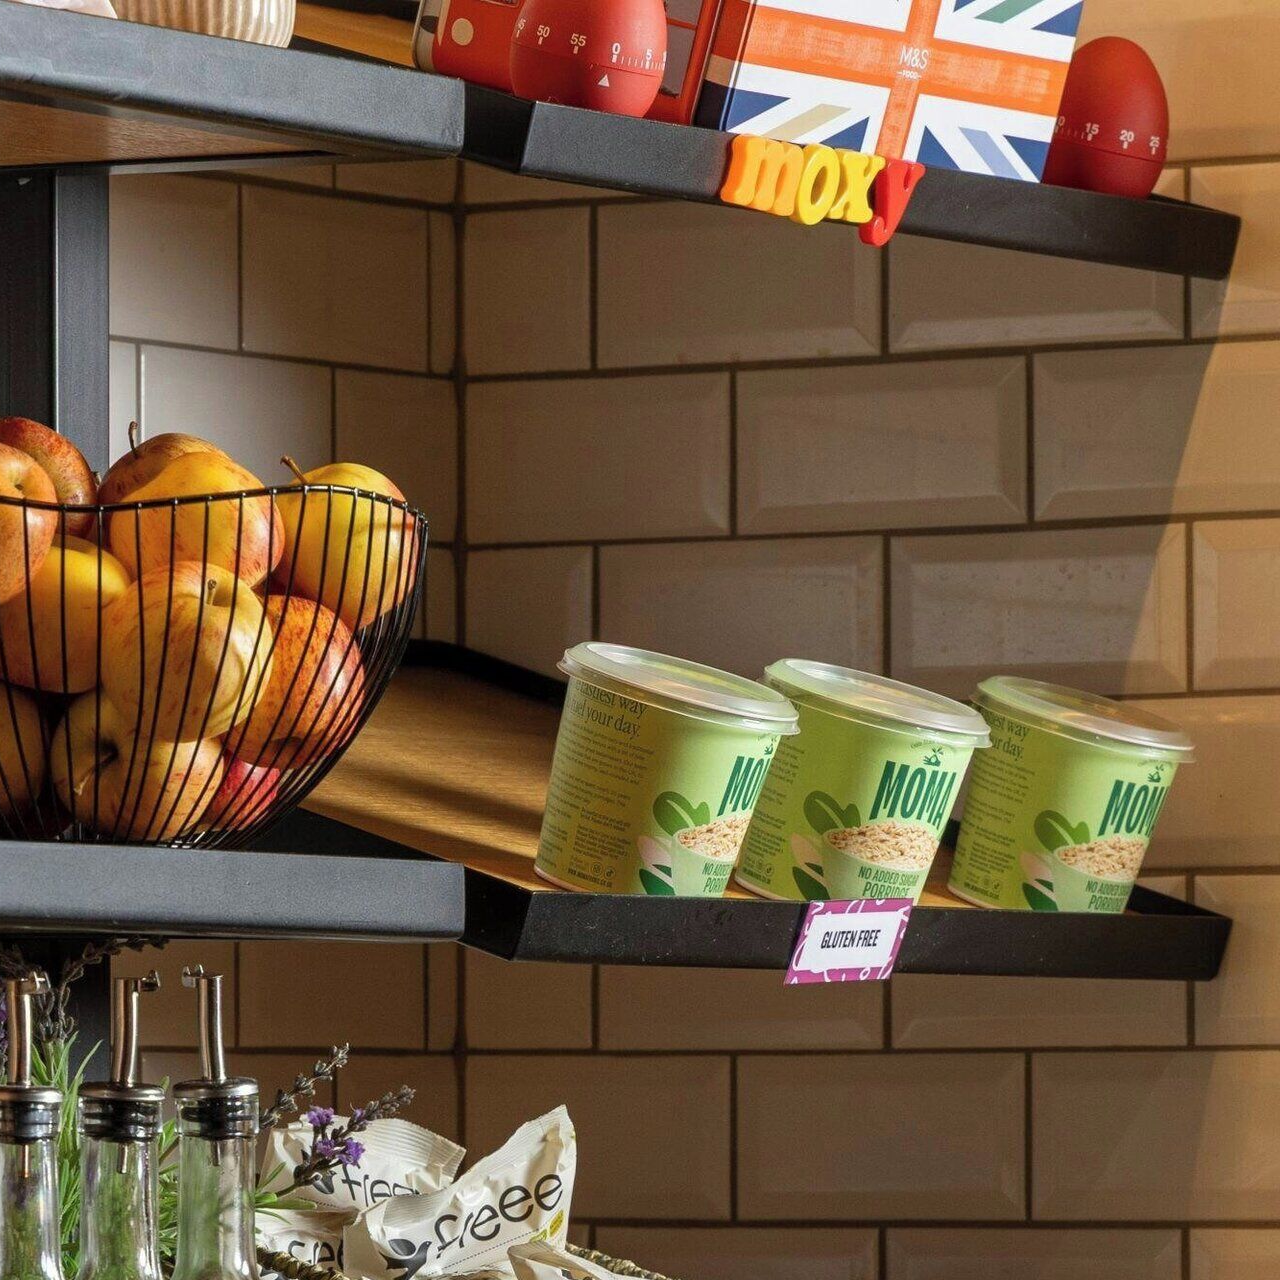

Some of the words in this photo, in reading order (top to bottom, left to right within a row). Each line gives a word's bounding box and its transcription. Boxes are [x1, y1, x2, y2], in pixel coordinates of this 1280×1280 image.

[536, 24, 550, 38] 50
[570, 33, 586, 47] 55
[611, 42, 621, 54] 0
[645, 48, 652, 60] 5
[898, 45, 929, 70] M&S
[1085, 122, 1099, 135] 15
[1120, 129, 1134, 142] 20
[585, 706, 614, 728] your
[869, 760, 957, 830] MOMA
[858, 866, 871, 879] NO
[872, 870, 900, 884] ADDED
[1085, 880, 1099, 893] NO
[821, 931, 859, 949] GLUTEN
[856, 929, 882, 947] FREE
